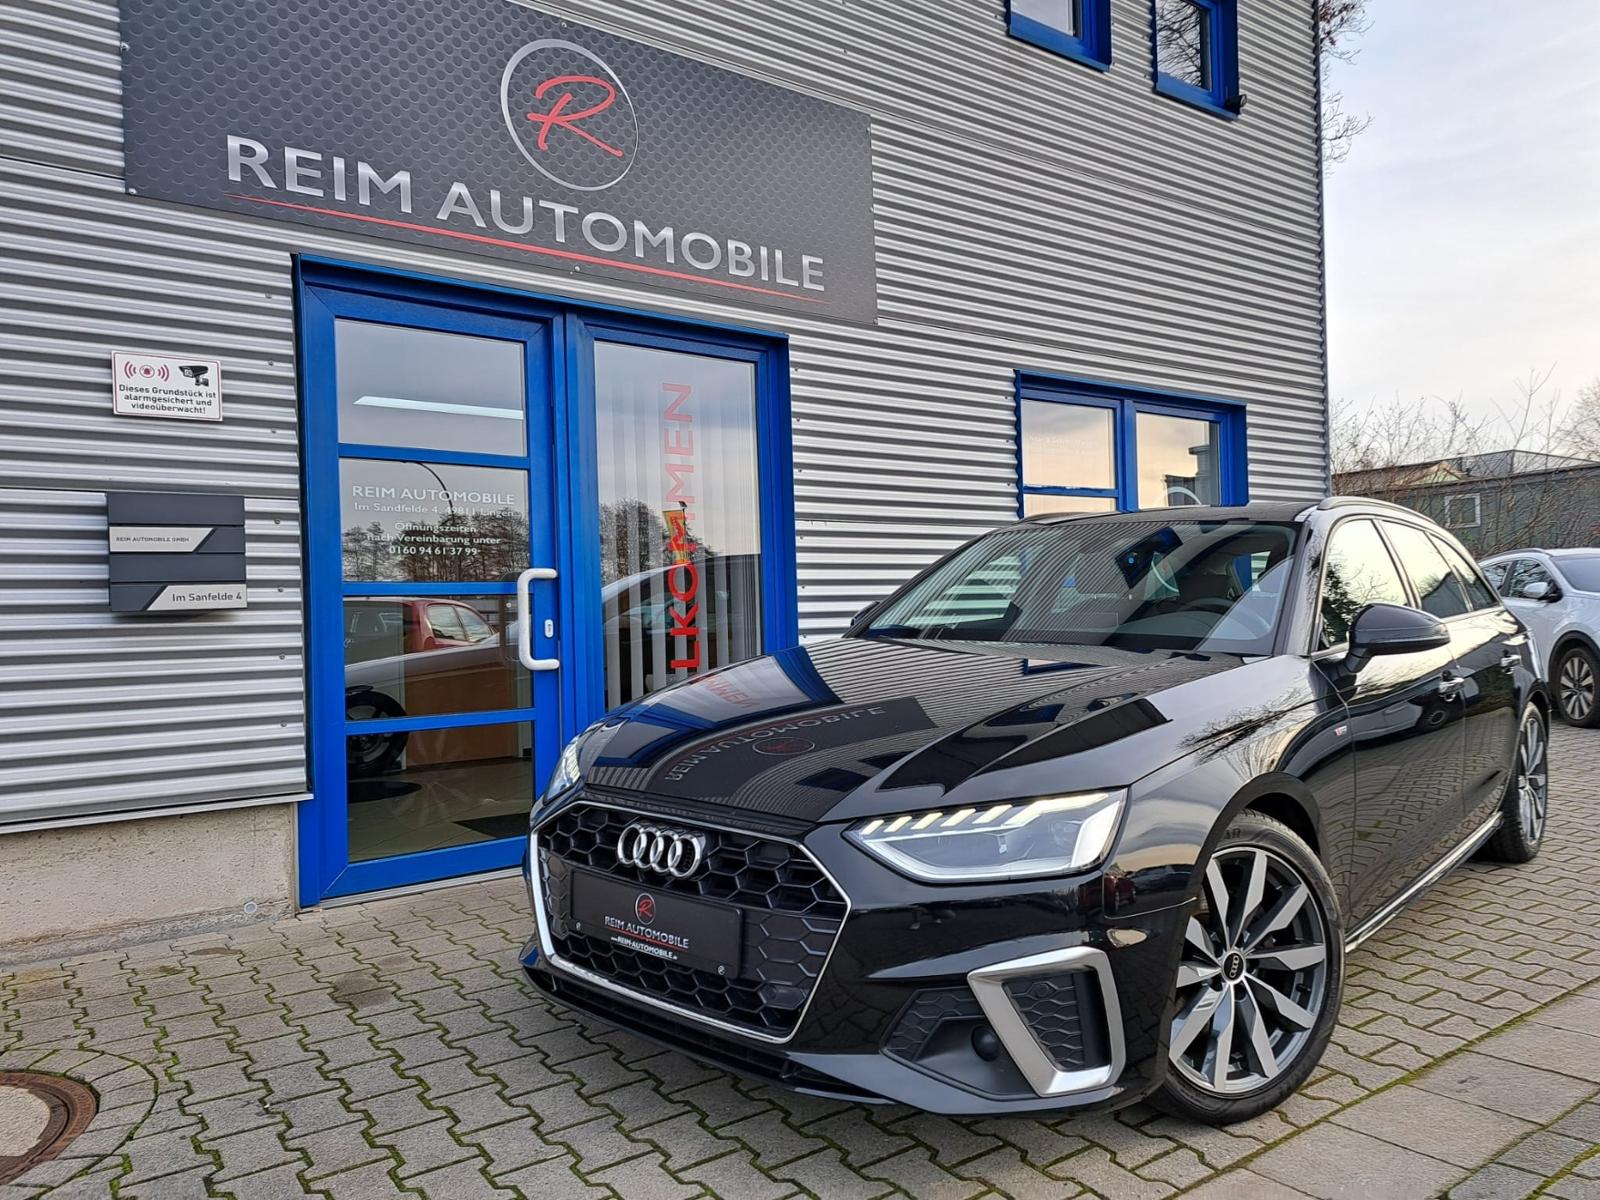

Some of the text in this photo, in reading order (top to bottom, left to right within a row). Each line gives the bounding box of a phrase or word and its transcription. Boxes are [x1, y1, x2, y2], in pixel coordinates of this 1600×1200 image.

[527, 75, 623, 157] R
[226, 134, 826, 293] REIM AUTOMOBILE
[119, 384, 217, 400] Dieses Grundstück ist
[124, 393, 213, 407] alarmgesichert und
[131, 402, 206, 415] videoüberwacht!
[352, 485, 516, 506] REIM AUTOMOBILE
[354, 501, 370, 511] Im
[373, 502, 429, 513] Sandfelde
[445, 506, 476, 516] 49811
[367, 532, 501, 545] nach Vereinbarung unter
[172, 592, 242, 602] Im Sanfelde 4
[604, 915, 690, 949] REIM AUTOMOBILE
